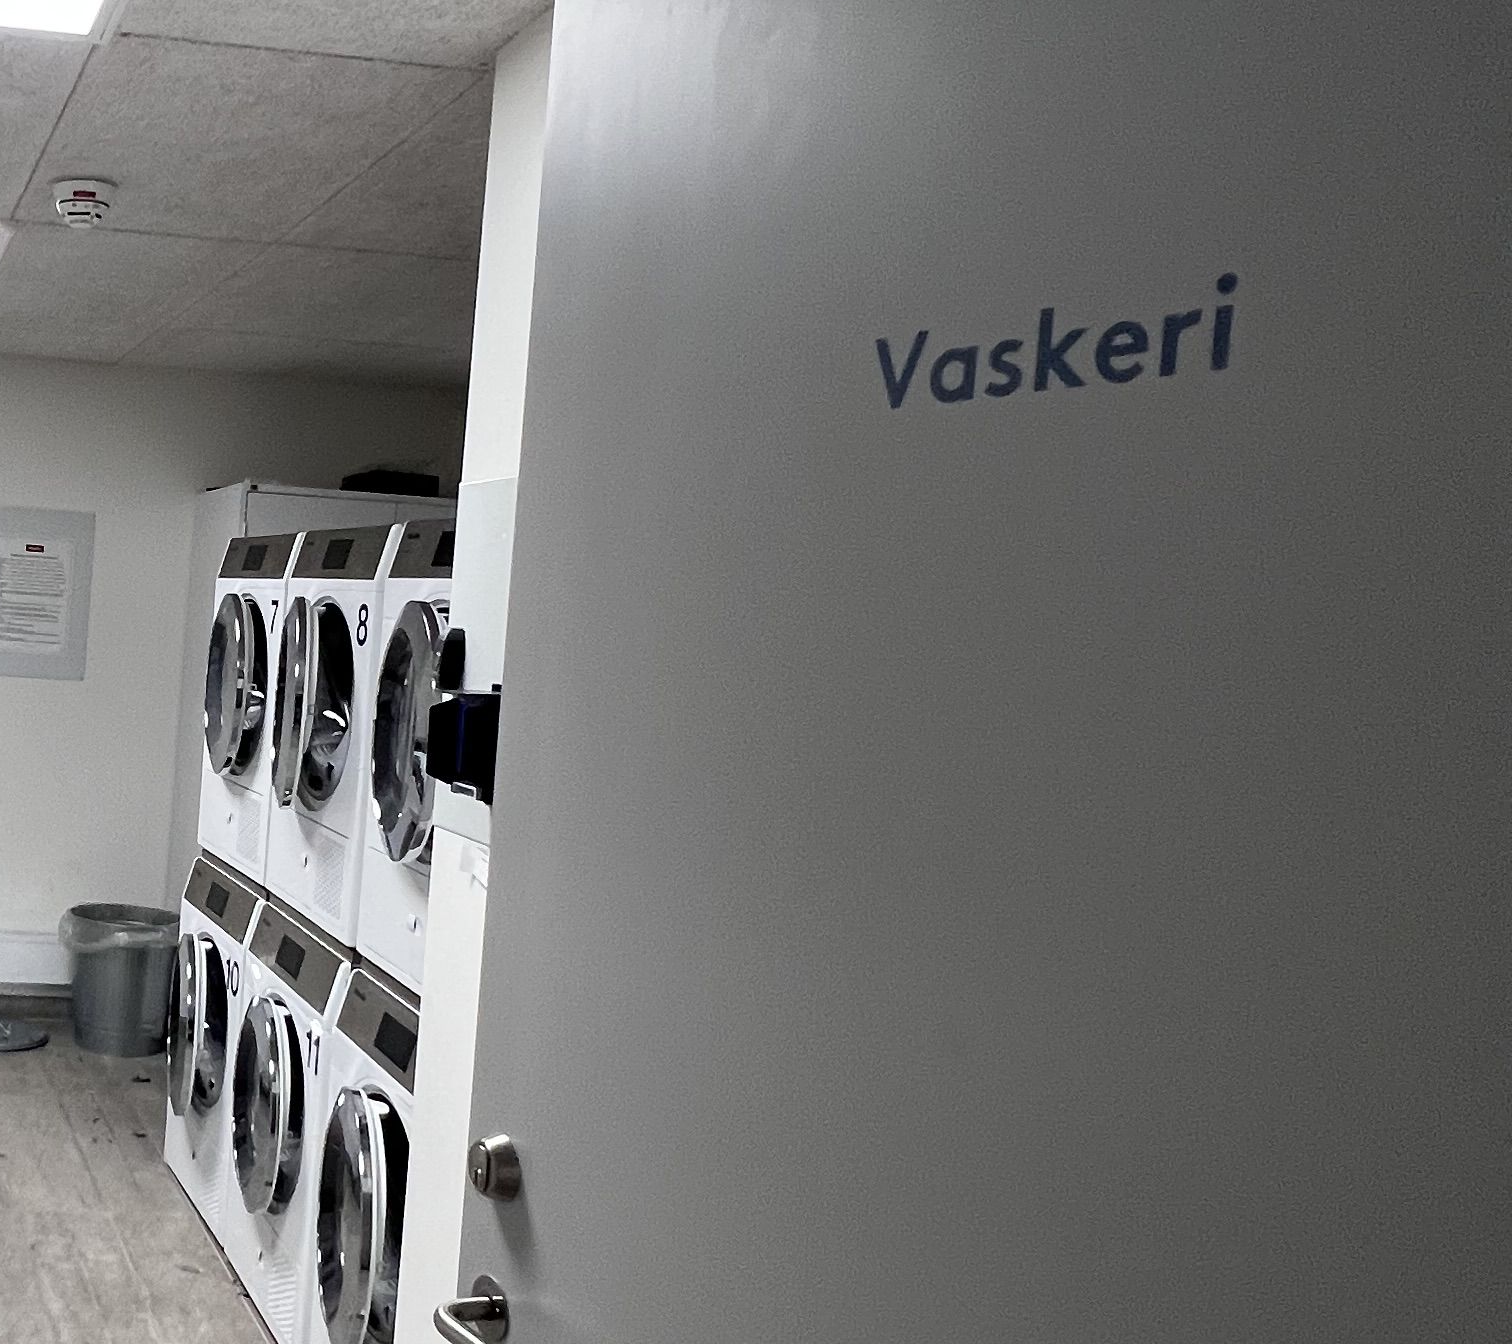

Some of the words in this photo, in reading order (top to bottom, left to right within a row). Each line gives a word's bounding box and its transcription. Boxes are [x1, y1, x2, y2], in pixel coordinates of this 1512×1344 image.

[875, 272, 1239, 410] Vaskeri
[270, 599, 280, 635] 7
[355, 603, 369, 647] 8
[226, 956, 240, 997] 10
[306, 1029, 321, 1076] 11
